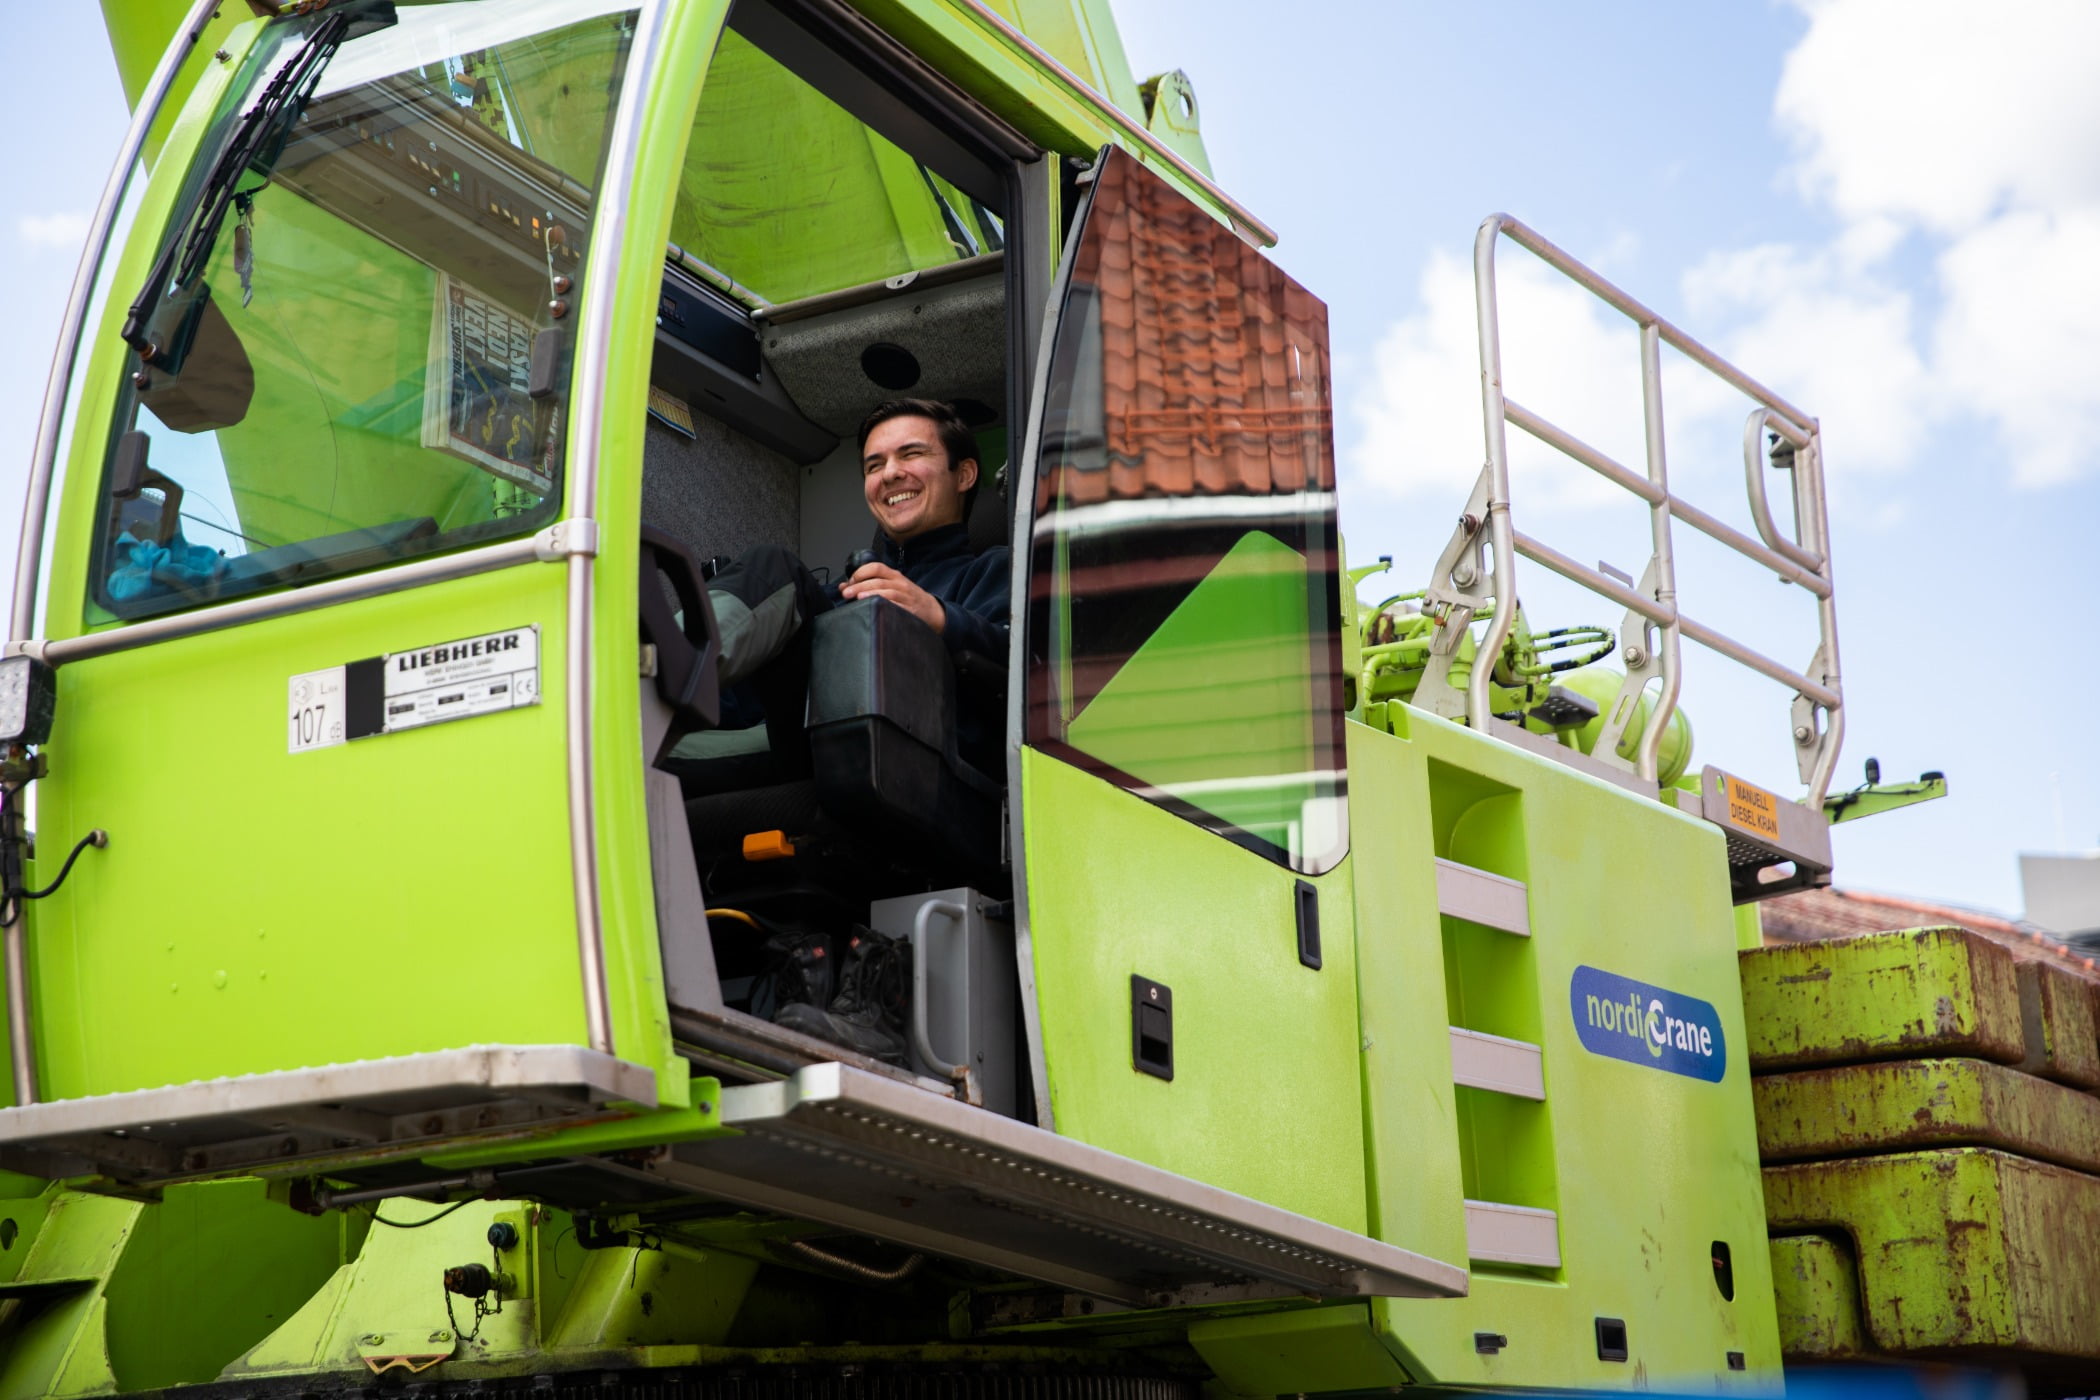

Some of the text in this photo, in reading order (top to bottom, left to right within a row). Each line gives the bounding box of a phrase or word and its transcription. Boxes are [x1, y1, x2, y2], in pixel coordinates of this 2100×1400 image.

[464, 296, 486, 361] VEKT
[487, 305, 509, 358] NED
[399, 634, 519, 672] LIEBHERR
[293, 704, 325, 745] 107
[1735, 783, 1769, 812] MANUELL
[1731, 802, 1778, 835] DIESEL KRAN
